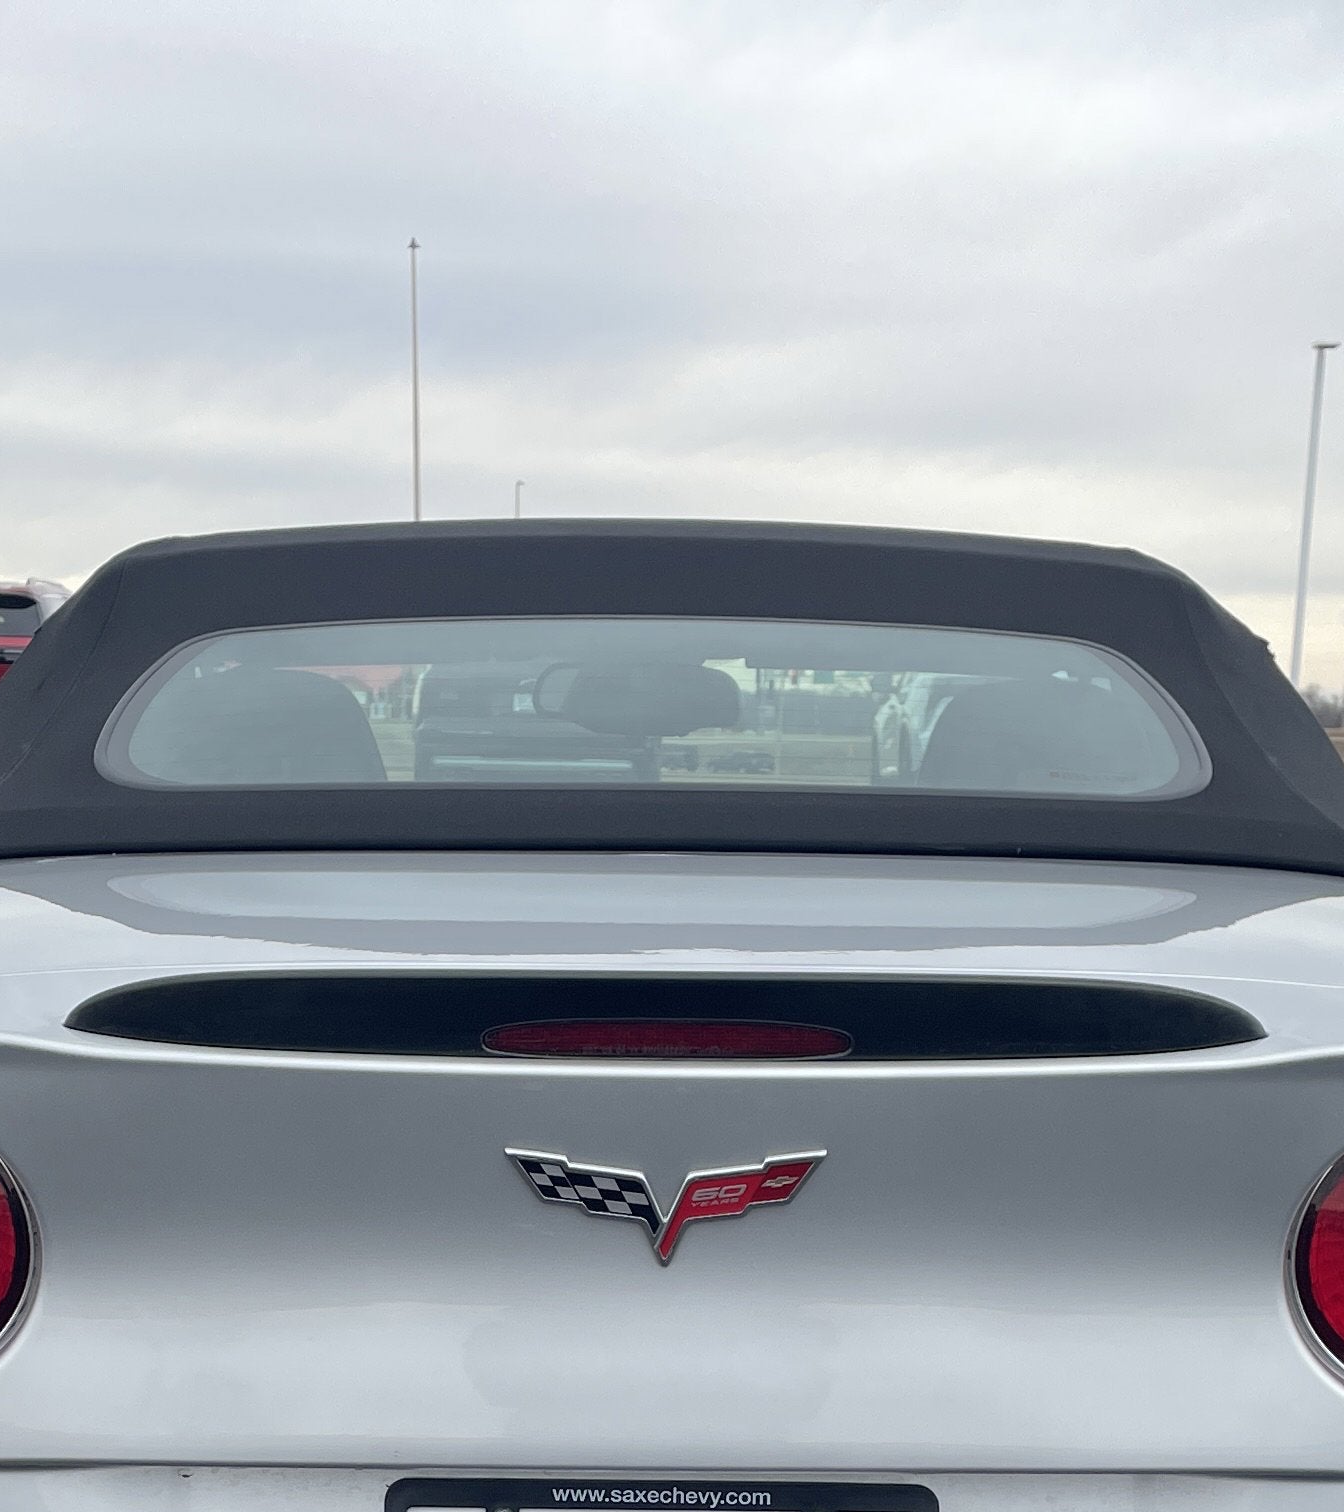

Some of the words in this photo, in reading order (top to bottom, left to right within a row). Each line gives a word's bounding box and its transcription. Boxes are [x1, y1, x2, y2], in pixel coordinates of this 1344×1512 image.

[691, 1183, 747, 1202] 60
[691, 1197, 740, 1207] YEARS
[551, 1486, 772, 1508] www.saxechevy.com
